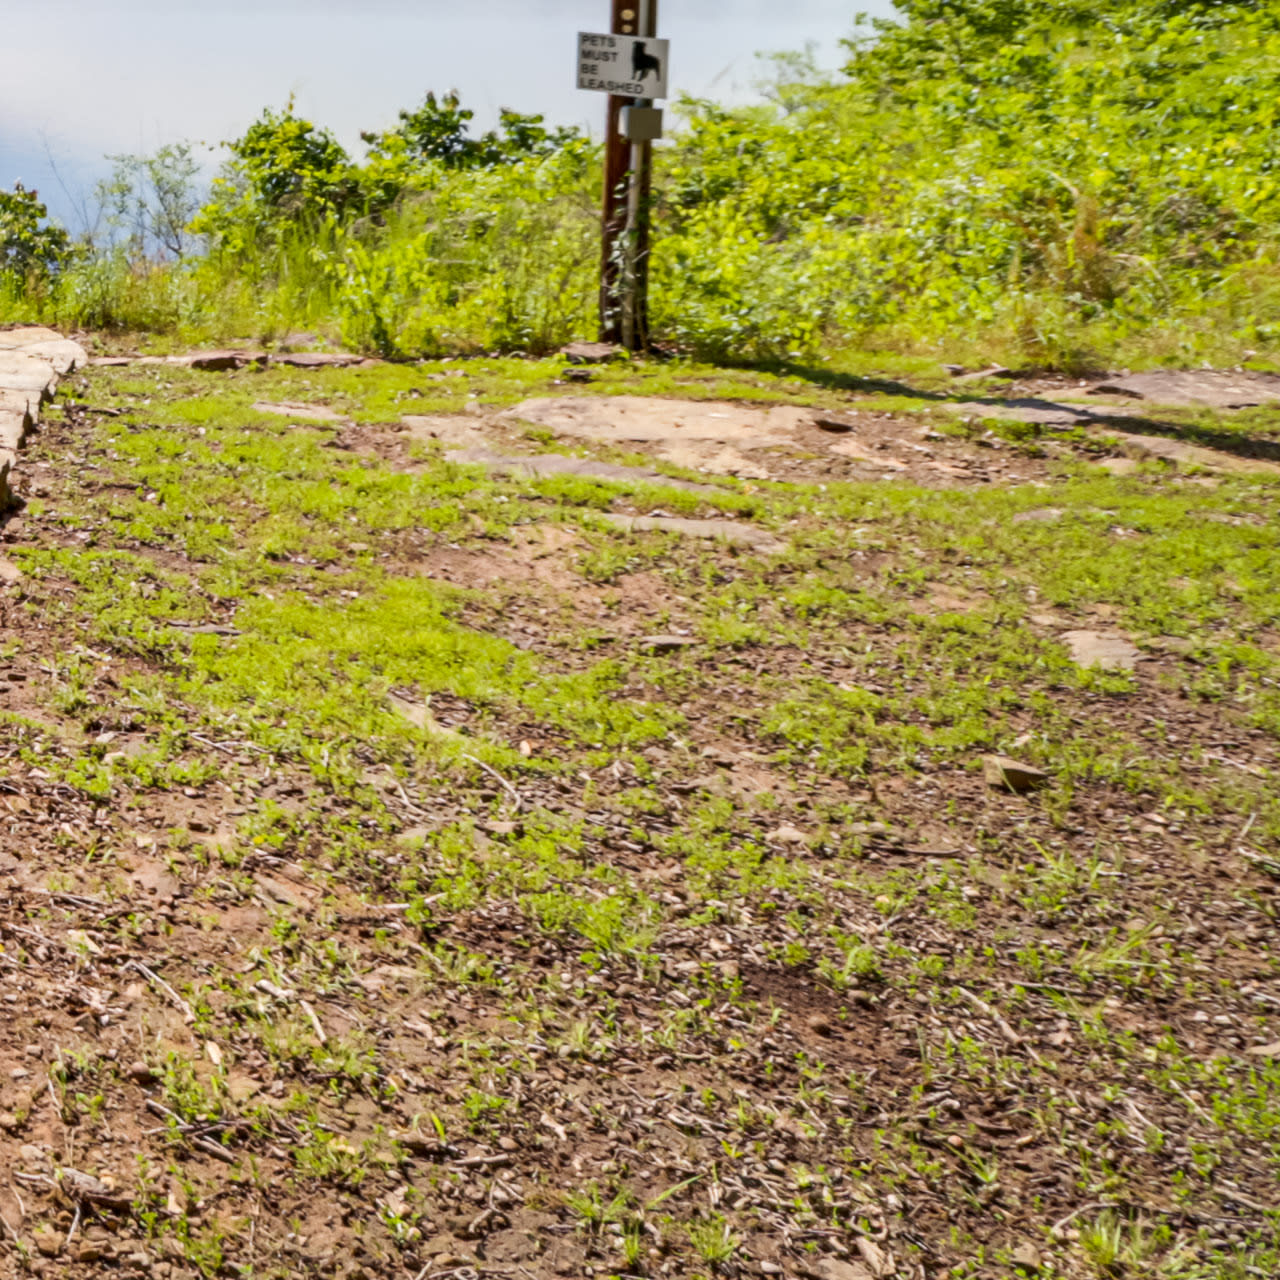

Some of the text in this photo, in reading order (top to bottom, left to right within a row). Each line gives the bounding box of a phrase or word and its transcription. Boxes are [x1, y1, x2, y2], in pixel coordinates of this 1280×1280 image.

[581, 35, 616, 47] PETS
[581, 49, 618, 62] MUST
[581, 64, 598, 75] BE
[580, 78, 644, 94] LEASHED
